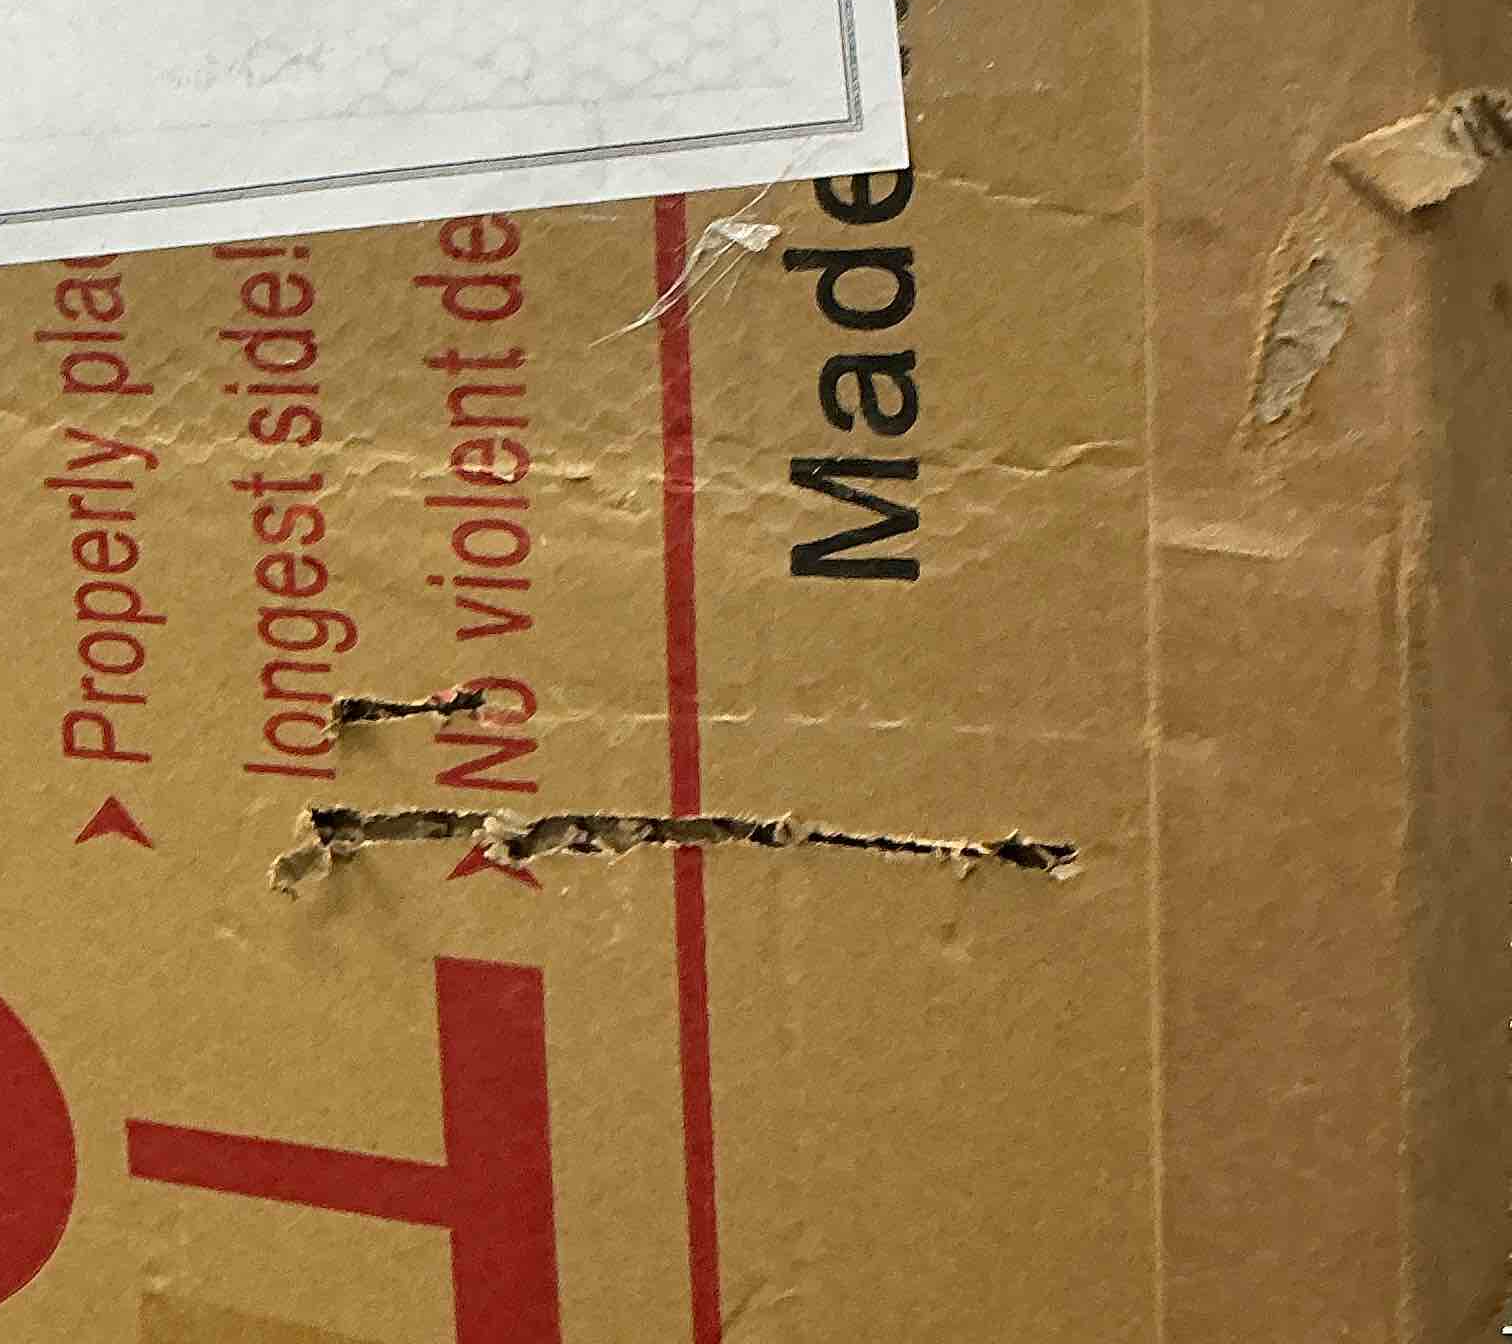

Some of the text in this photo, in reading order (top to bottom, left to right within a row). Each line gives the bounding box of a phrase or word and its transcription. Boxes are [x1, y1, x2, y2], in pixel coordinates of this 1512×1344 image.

[211, 245, 358, 780] longest side!
[424, 348, 532, 642] violent
[782, 167, 920, 581] Made
[44, 426, 168, 763] Properly
[435, 675, 538, 794] No
